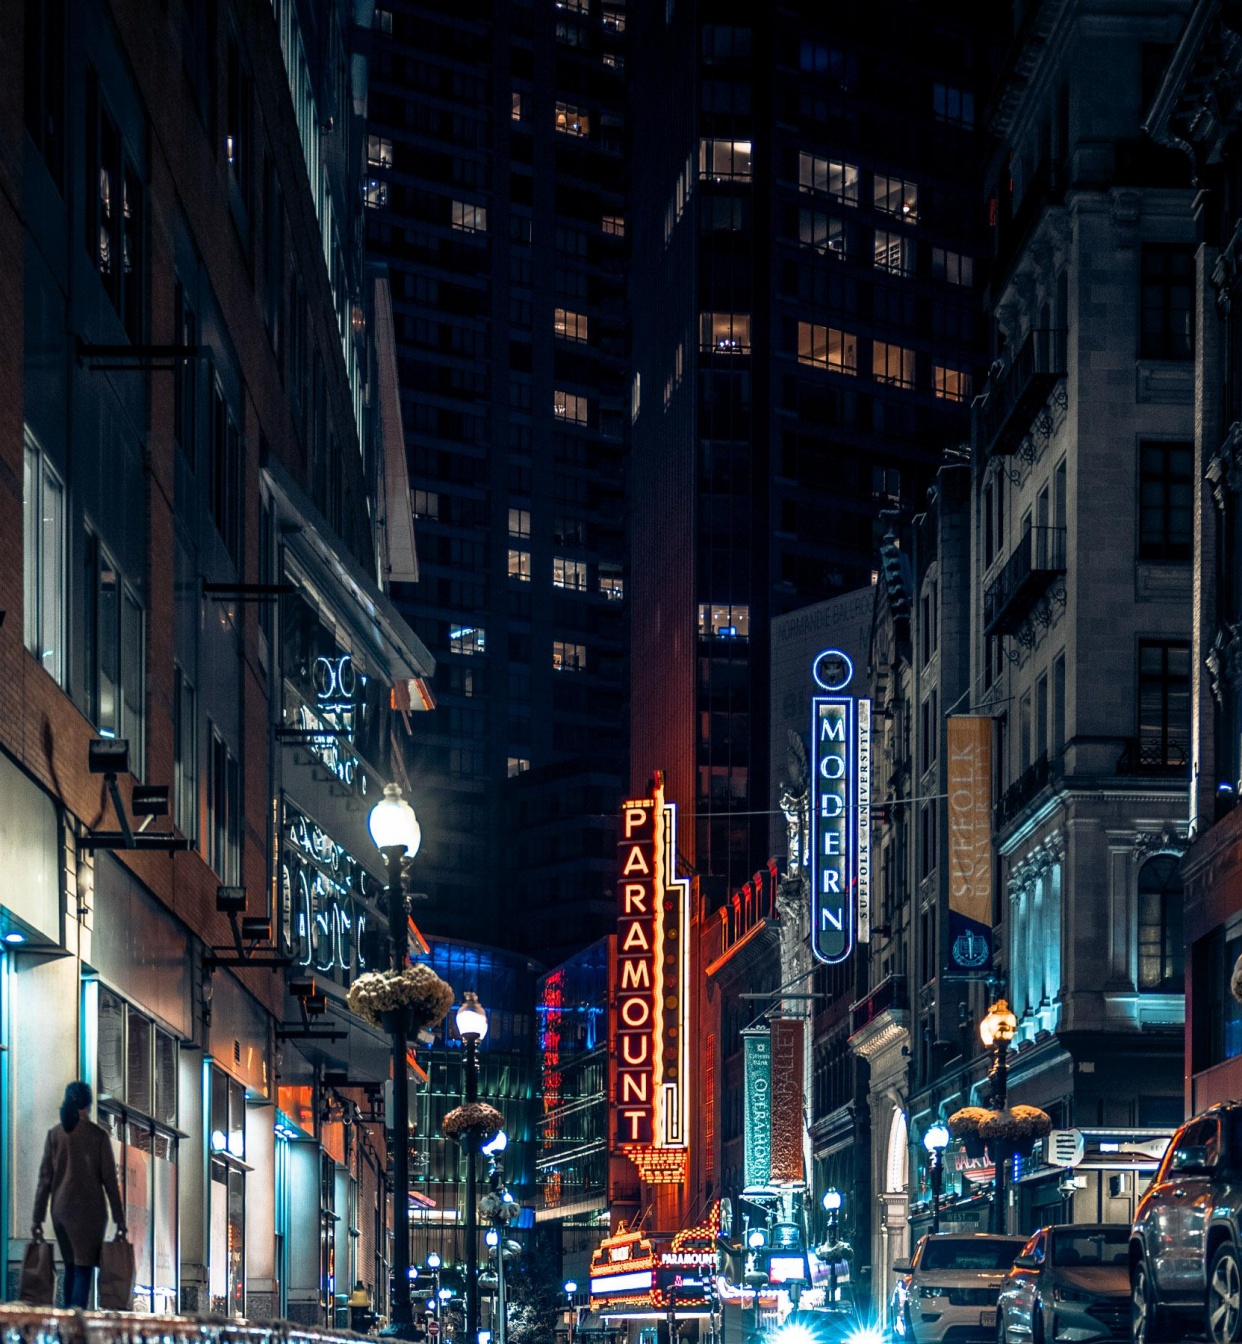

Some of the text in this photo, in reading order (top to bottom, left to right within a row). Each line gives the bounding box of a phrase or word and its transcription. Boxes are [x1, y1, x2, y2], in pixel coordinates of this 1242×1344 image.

[820, 718, 846, 931] MODERN
[860, 727, 869, 919] SUFFOLK UNIVERSITY
[953, 745, 975, 897] SUFFOLK
[621, 808, 650, 1140] PARAMOUNT
[662, 1253, 717, 1265] PARAMOUNT
[947, 1213, 966, 1221] WEST
